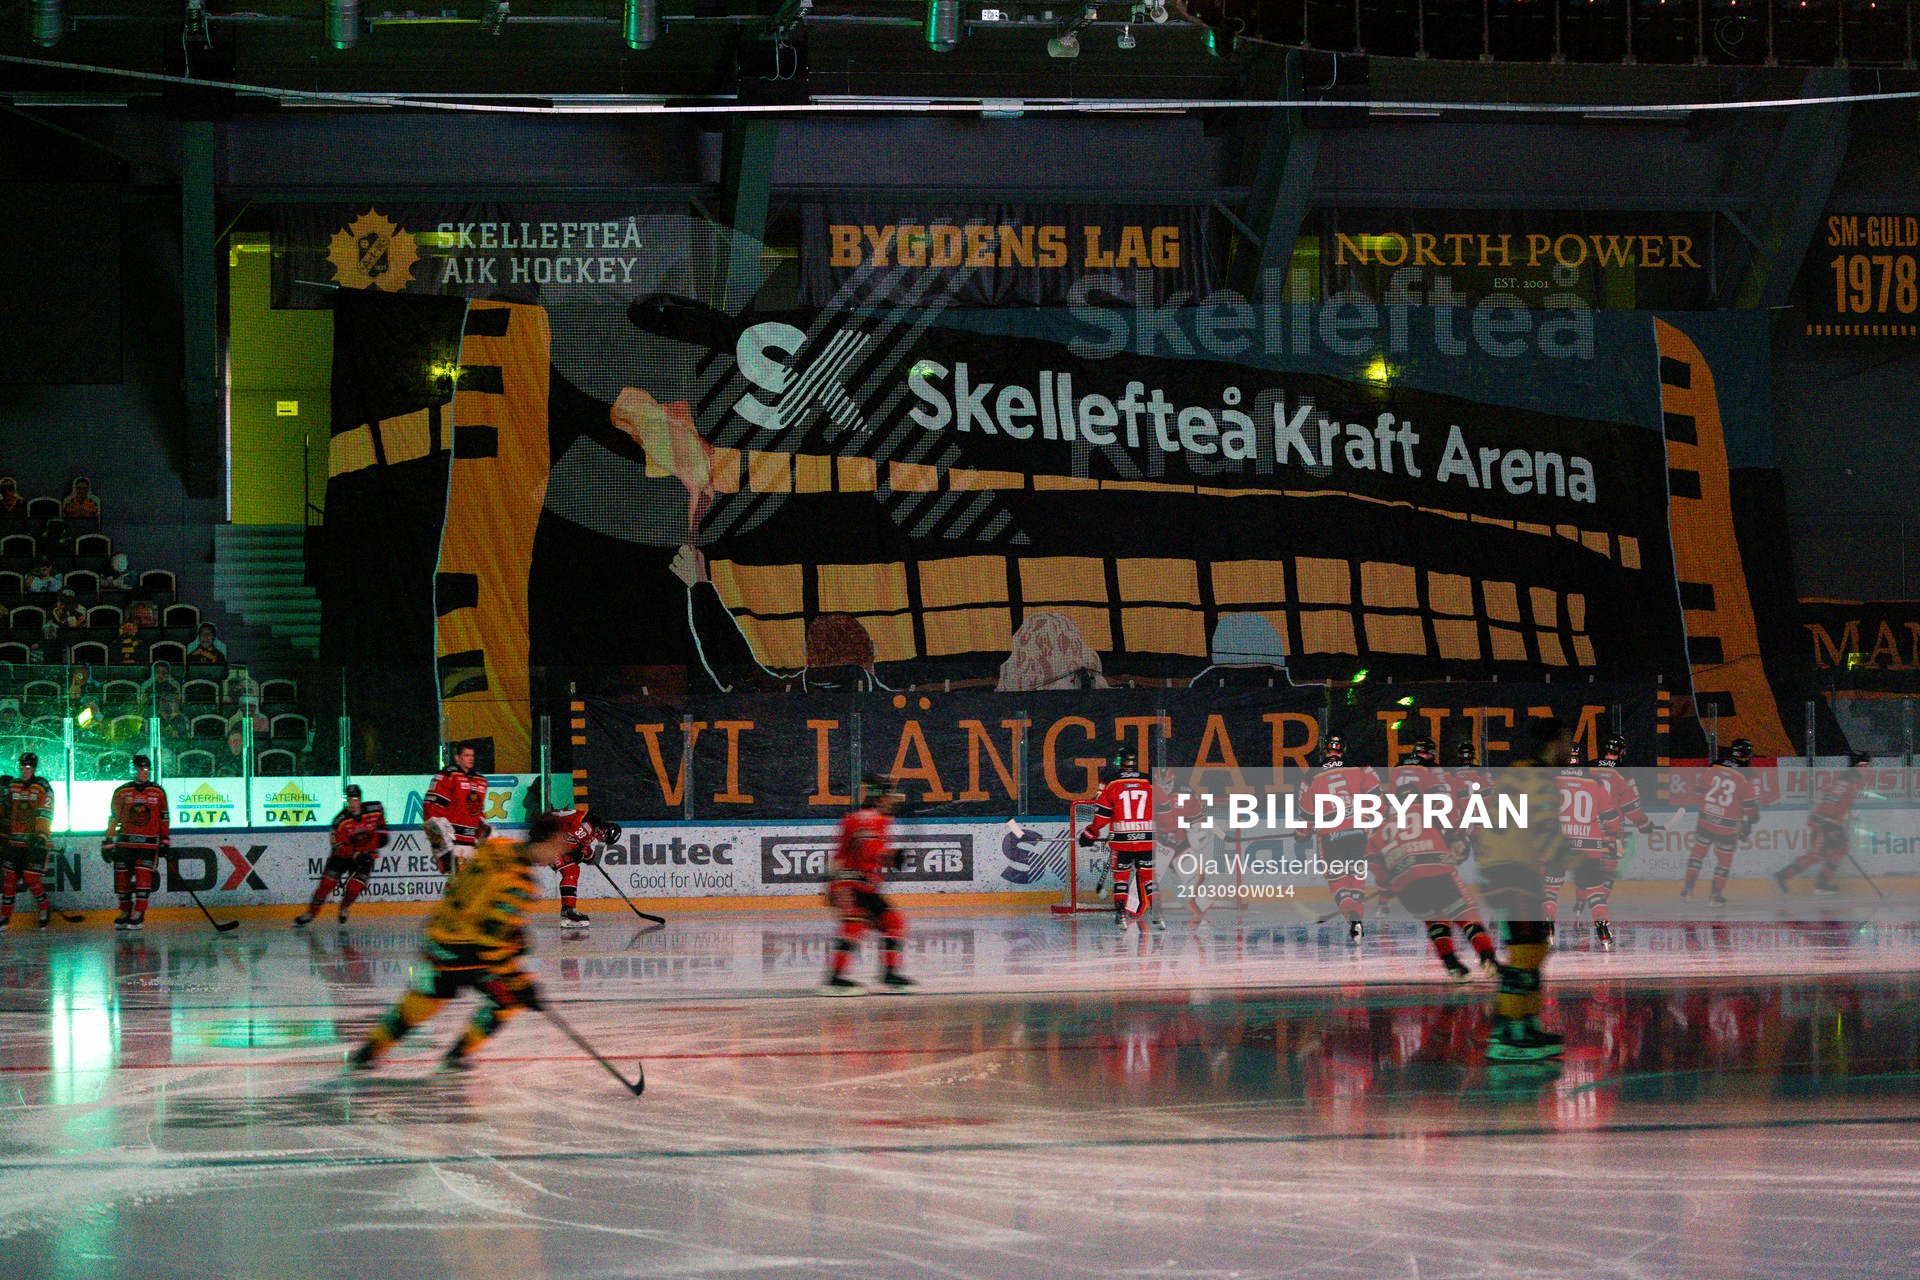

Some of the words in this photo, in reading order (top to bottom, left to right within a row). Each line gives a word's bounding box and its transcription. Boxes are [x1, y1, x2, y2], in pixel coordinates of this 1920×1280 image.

[437, 216, 643, 250] SKELLEFTEÅ
[829, 224, 1070, 268] BYGDENS
[1084, 226, 1181, 268] LAG
[1827, 215, 1919, 248] SM-GULD
[1335, 232, 1512, 267] NORTH
[1526, 233, 1702, 268] POWER
[442, 257, 497, 285] AIK
[511, 257, 638, 284] HOCKEY
[1494, 278, 1520, 289] EST.
[1523, 280, 1549, 290] 2001
[1831, 254, 1918, 314] 1978
[1067, 262, 1595, 360] Skellefteå
[908, 359, 1257, 460] Skellefteå
[1273, 401, 1421, 478] Kraft
[1437, 424, 1596, 504] Arena
[635, 720, 755, 807] VI
[806, 695, 1326, 807] LÄNGTAR
[1119, 789, 1148, 820] 17
[1559, 788, 1593, 824] 20
[1705, 775, 1736, 807] 23
[179, 811, 231, 823] DATA
[266, 810, 318, 822] DATA
[1560, 824, 1591, 837] NNOLLY
[924, 848, 965, 873] AB
[630, 872, 666, 889] Good
[671, 872, 690, 888] for
[694, 871, 733, 888] Wood
